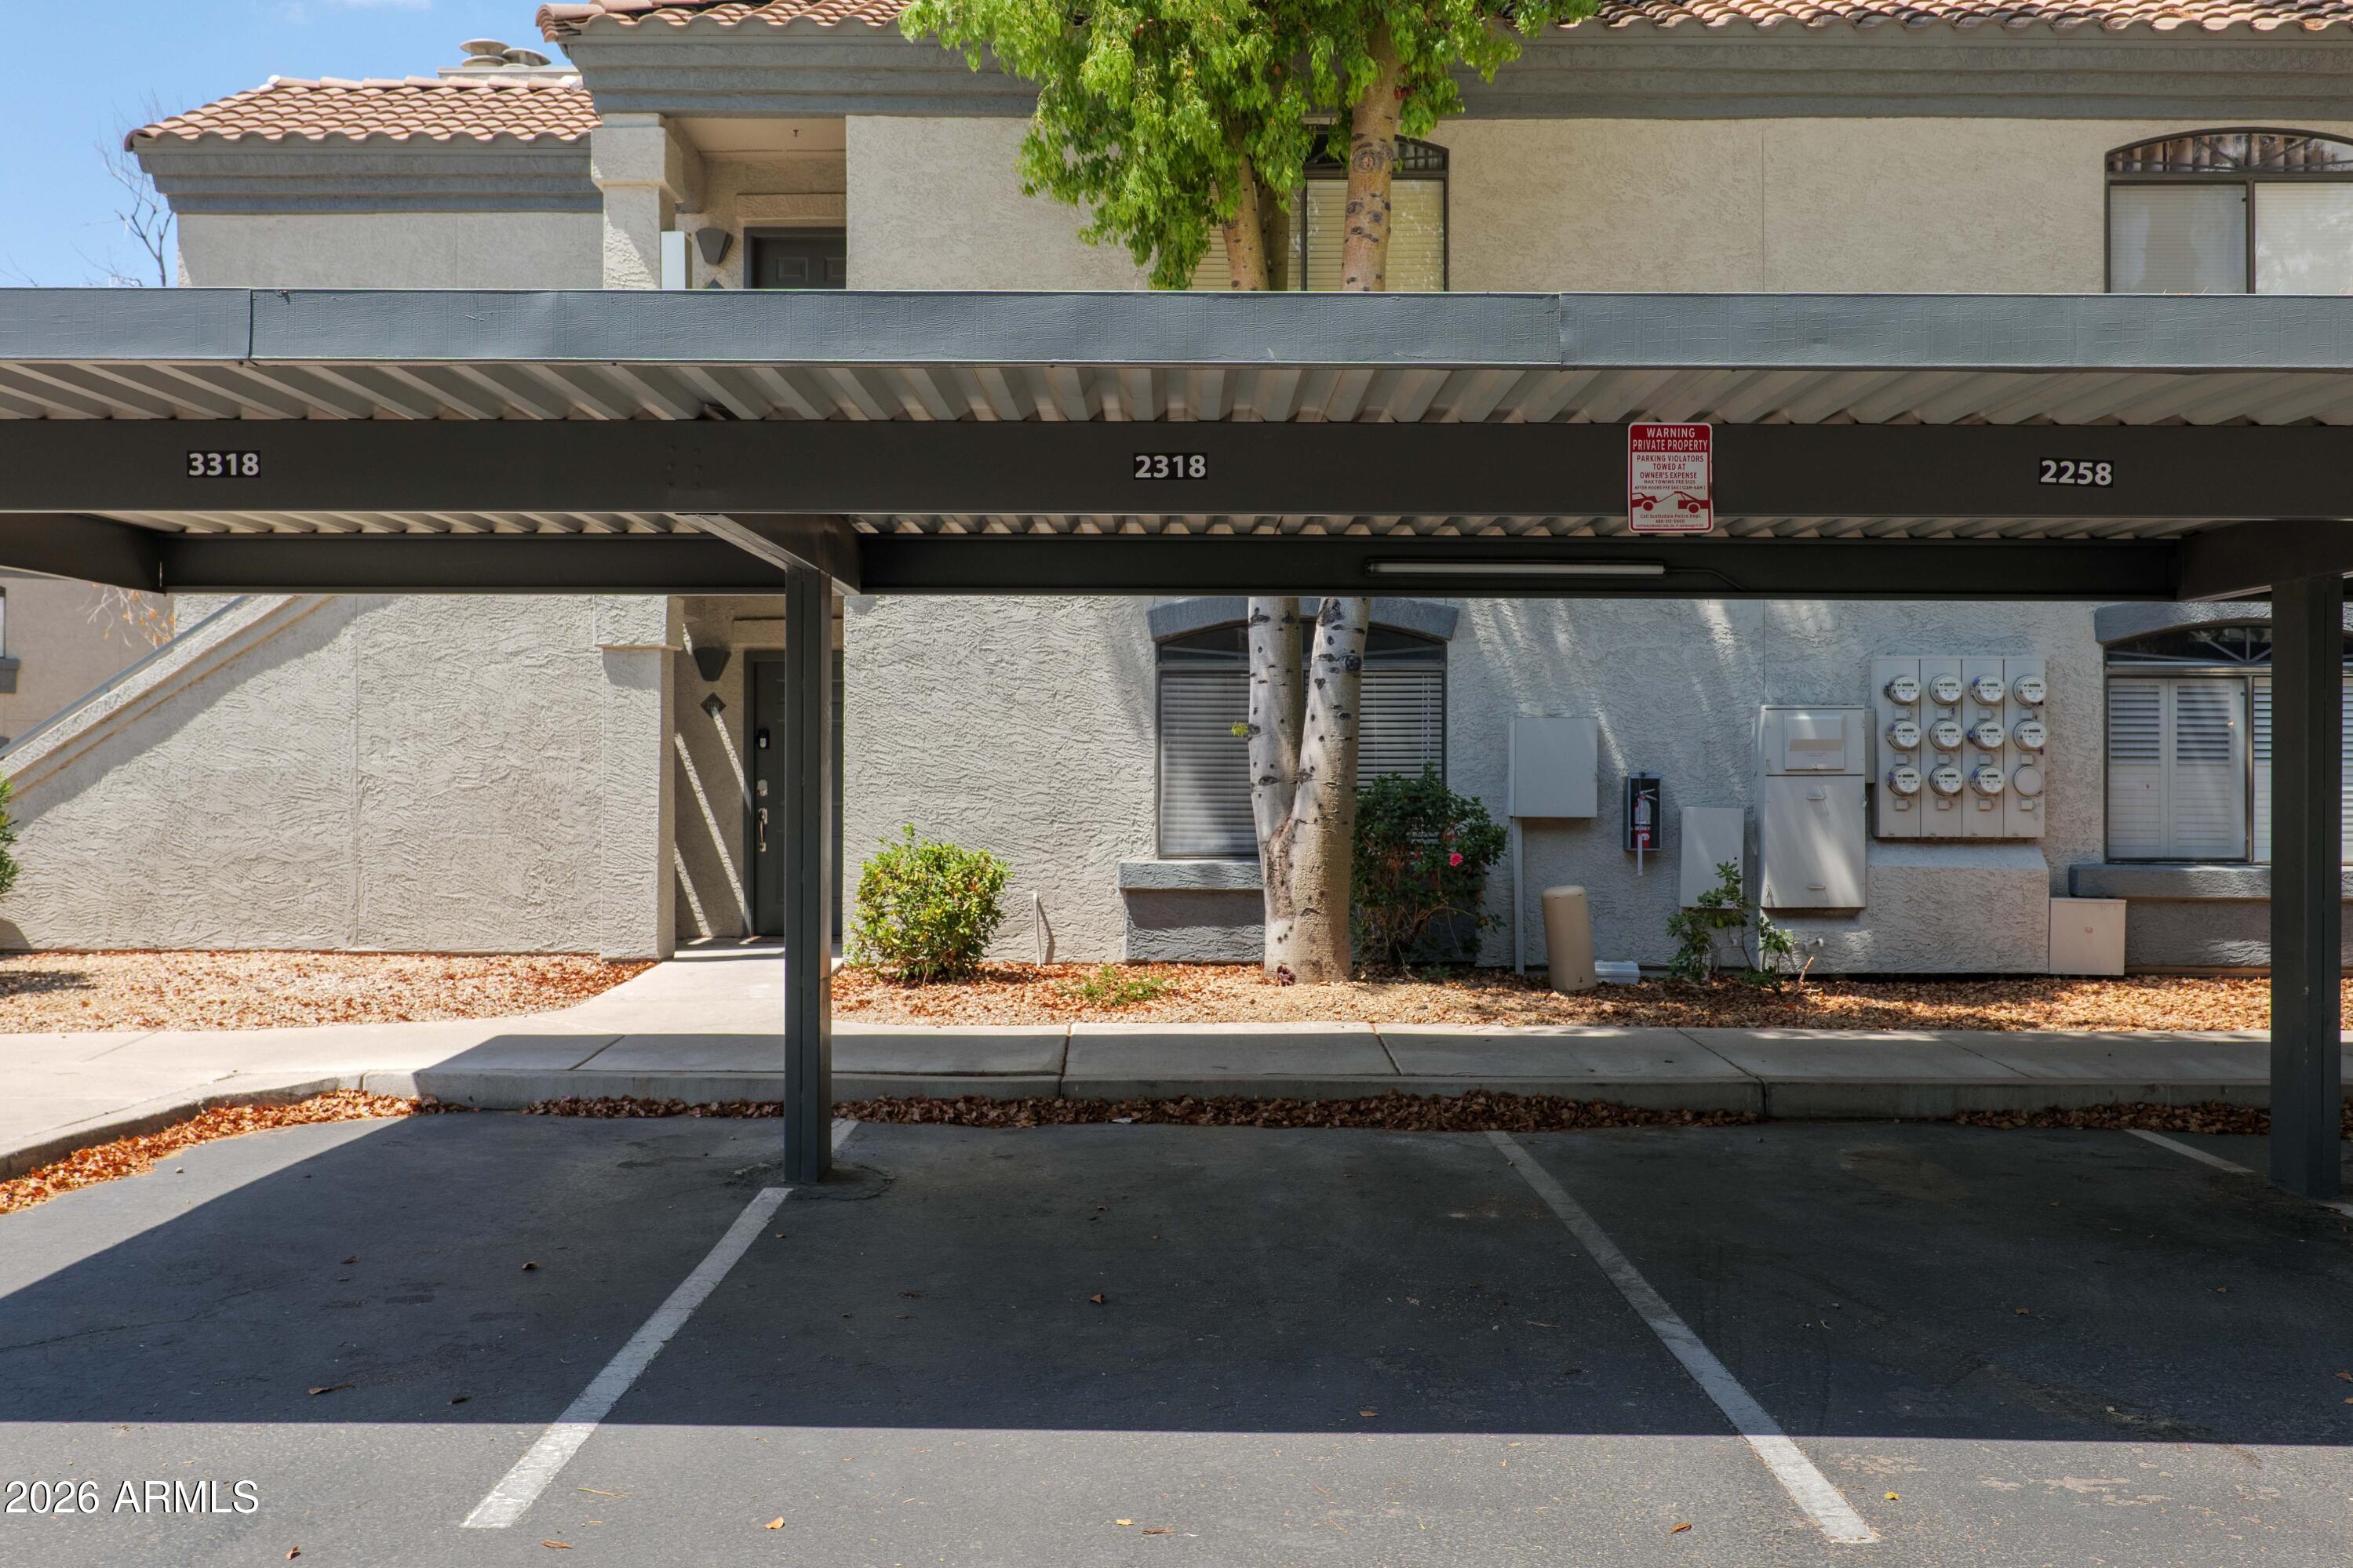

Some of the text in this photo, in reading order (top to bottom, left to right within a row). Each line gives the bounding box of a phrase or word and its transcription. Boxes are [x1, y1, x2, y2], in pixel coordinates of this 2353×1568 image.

[1646, 427, 1696, 438] WARNING
[1633, 439, 1708, 451] PRIVATE PROPERTY
[188, 453, 259, 476] 3318
[1135, 455, 1206, 478] 2318
[2040, 460, 2112, 486] 2258
